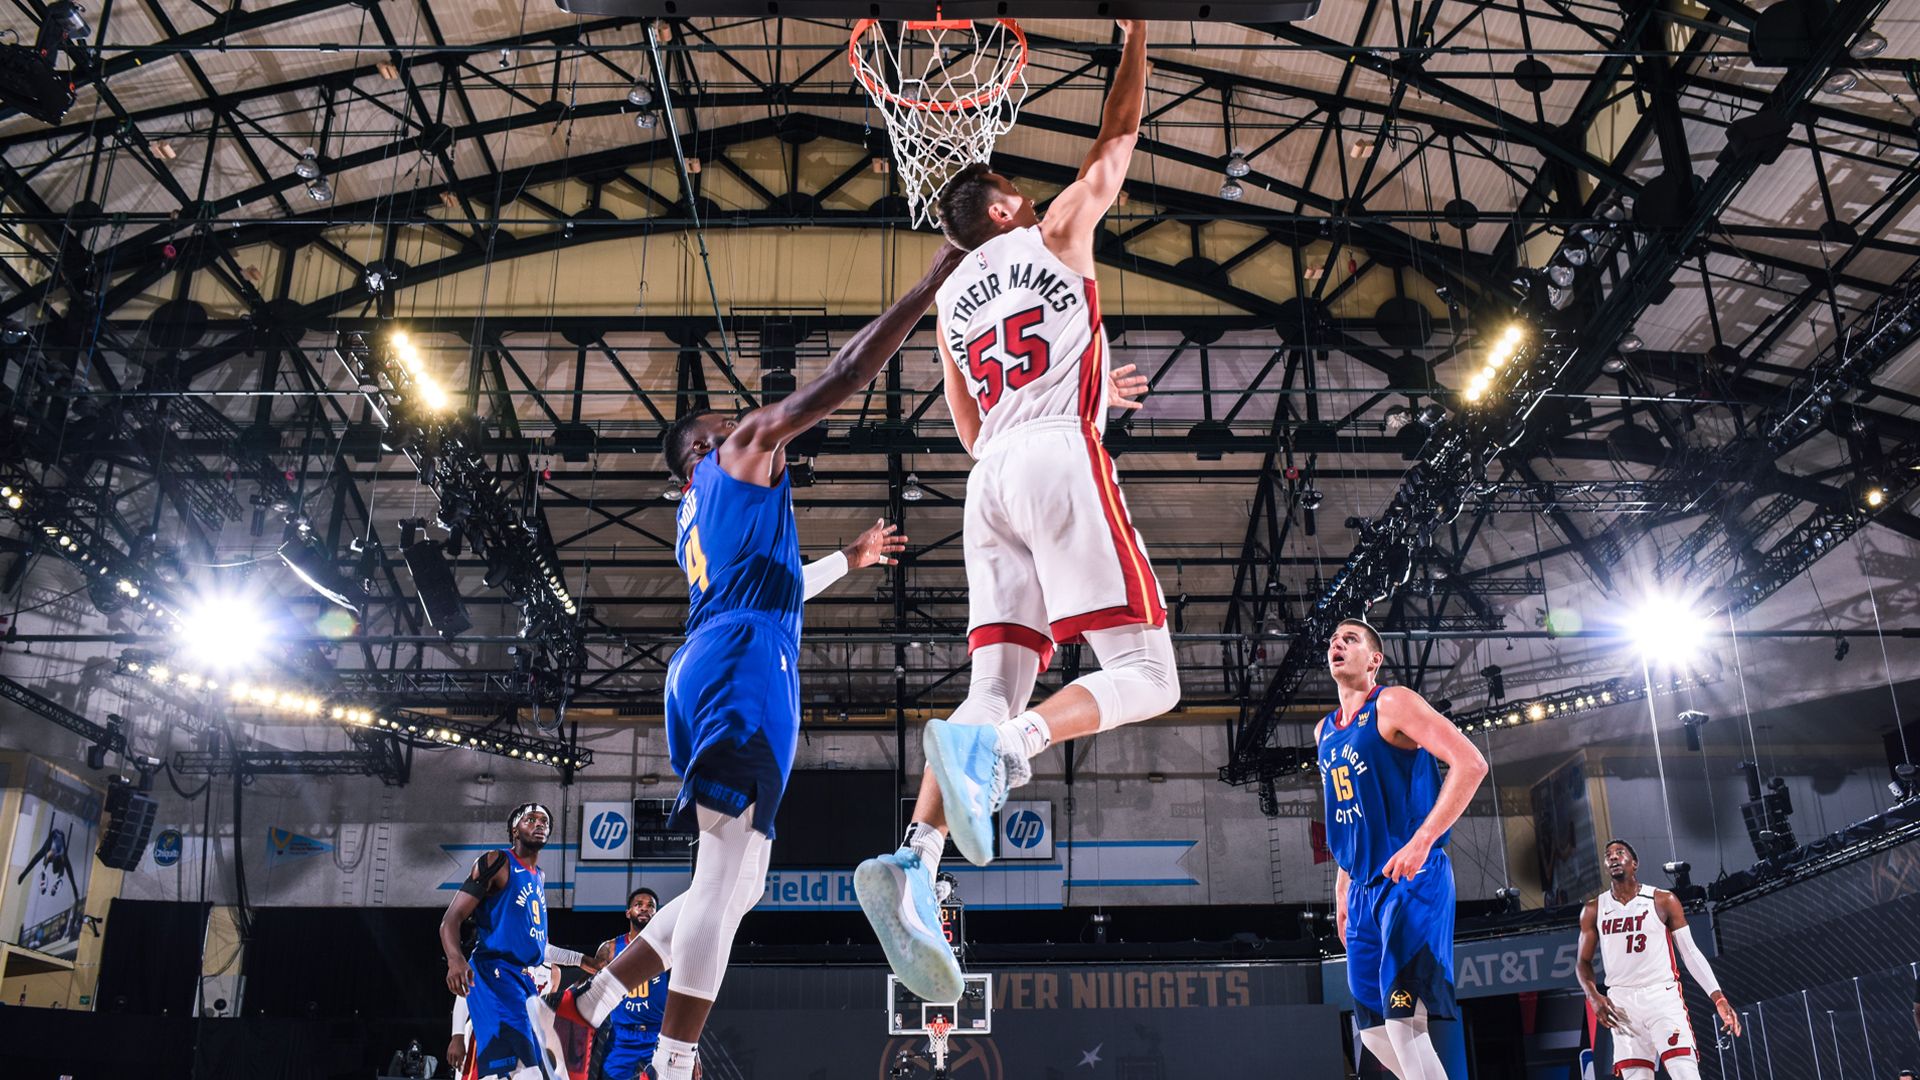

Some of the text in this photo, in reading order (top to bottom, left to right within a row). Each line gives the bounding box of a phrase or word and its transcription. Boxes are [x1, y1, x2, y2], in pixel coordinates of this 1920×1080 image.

[952, 272, 1002, 323] THEIR
[1008, 263, 1077, 313] NAMES
[966, 304, 1050, 416] 55
[685, 525, 710, 593] 4
[1341, 744, 1368, 776] HIGH
[1331, 765, 1354, 802] 15
[593, 810, 626, 850] hp
[1010, 808, 1041, 849] hp
[1336, 803, 1362, 825] CITY
[515, 882, 534, 908] MILE
[532, 900, 541, 925] 9
[1601, 910, 1649, 935] HEAT
[1626, 933, 1648, 954] 13
[1456, 948, 1545, 989] AT&T
[625, 1000, 650, 1012] CITY
[992, 970, 1250, 1009] VER NUGGETS
